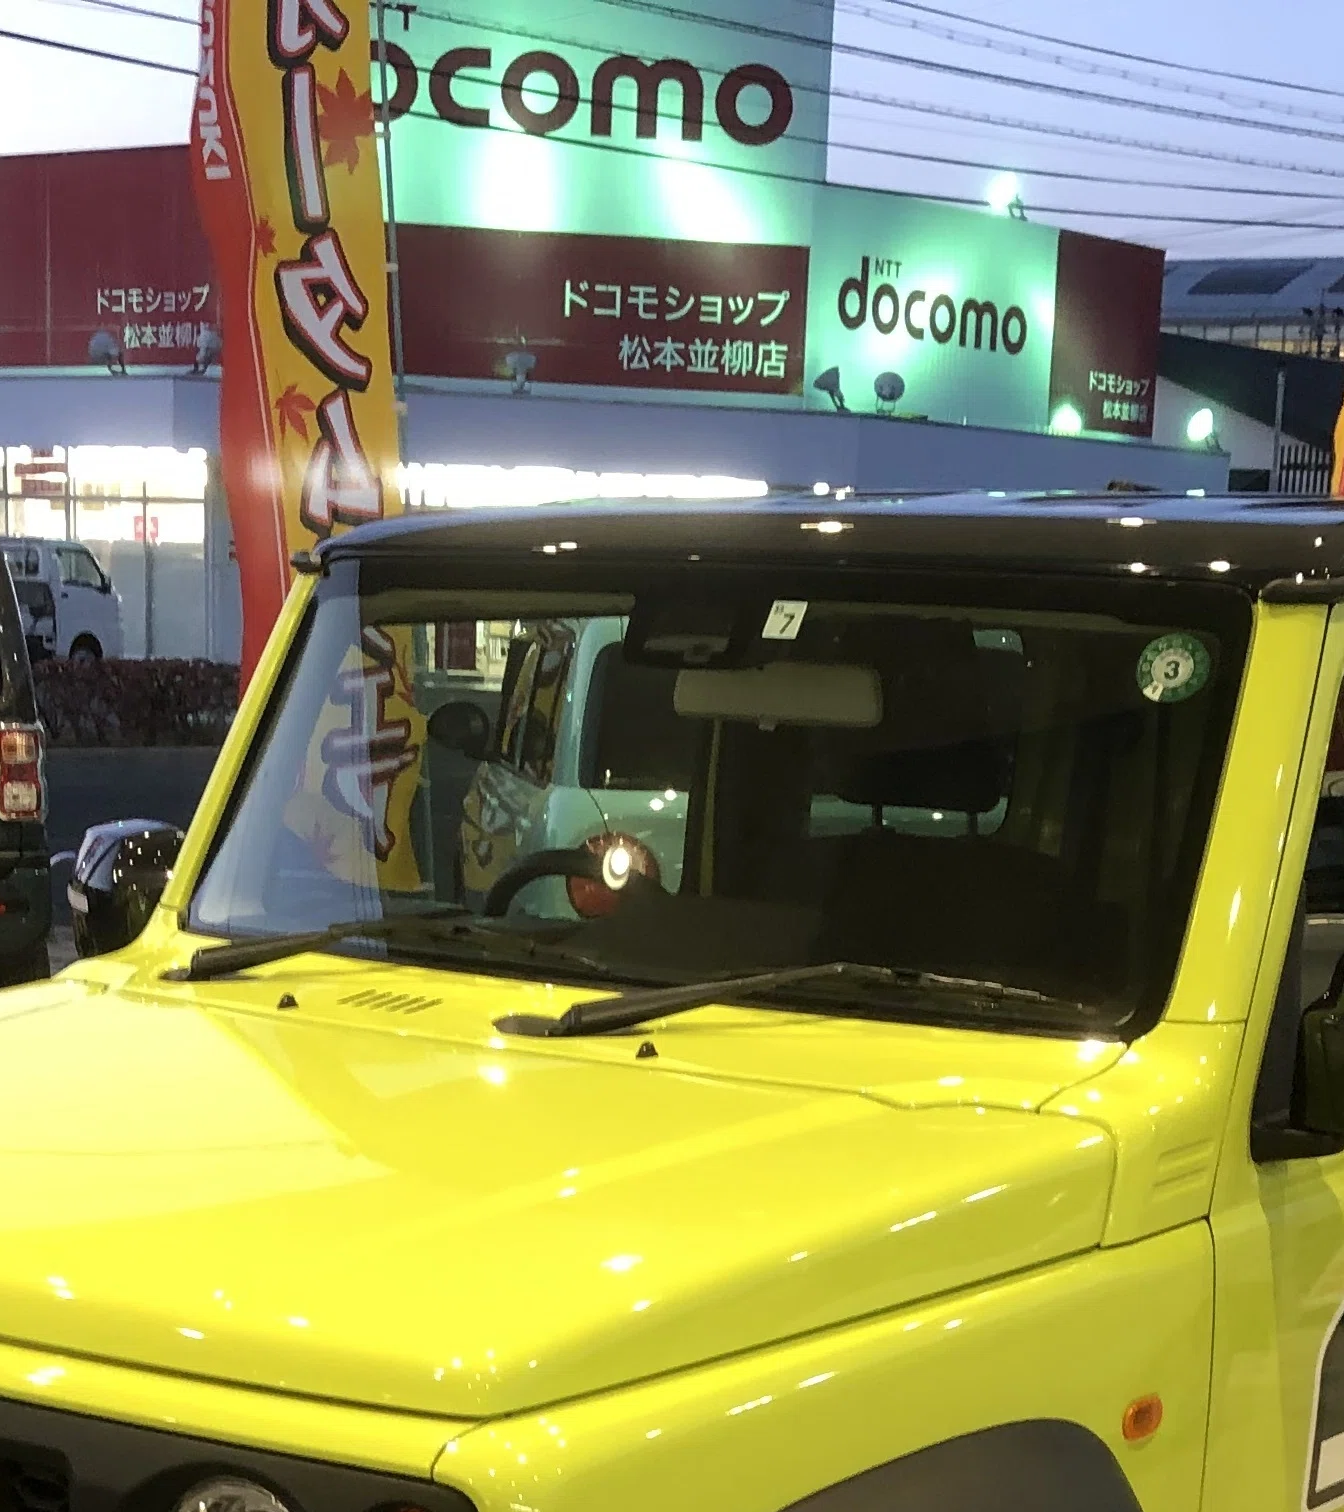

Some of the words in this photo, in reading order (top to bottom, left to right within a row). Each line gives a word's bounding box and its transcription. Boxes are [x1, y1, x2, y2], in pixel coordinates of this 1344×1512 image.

[370, 40, 794, 147] ocomo
[873, 257, 902, 279] NTT
[97, 283, 210, 315] ドコモショップ
[564, 279, 791, 327] ドコモショップ
[838, 256, 1028, 355] docomo
[618, 333, 789, 378] 松本並柳店
[1163, 660, 1181, 680] 3
